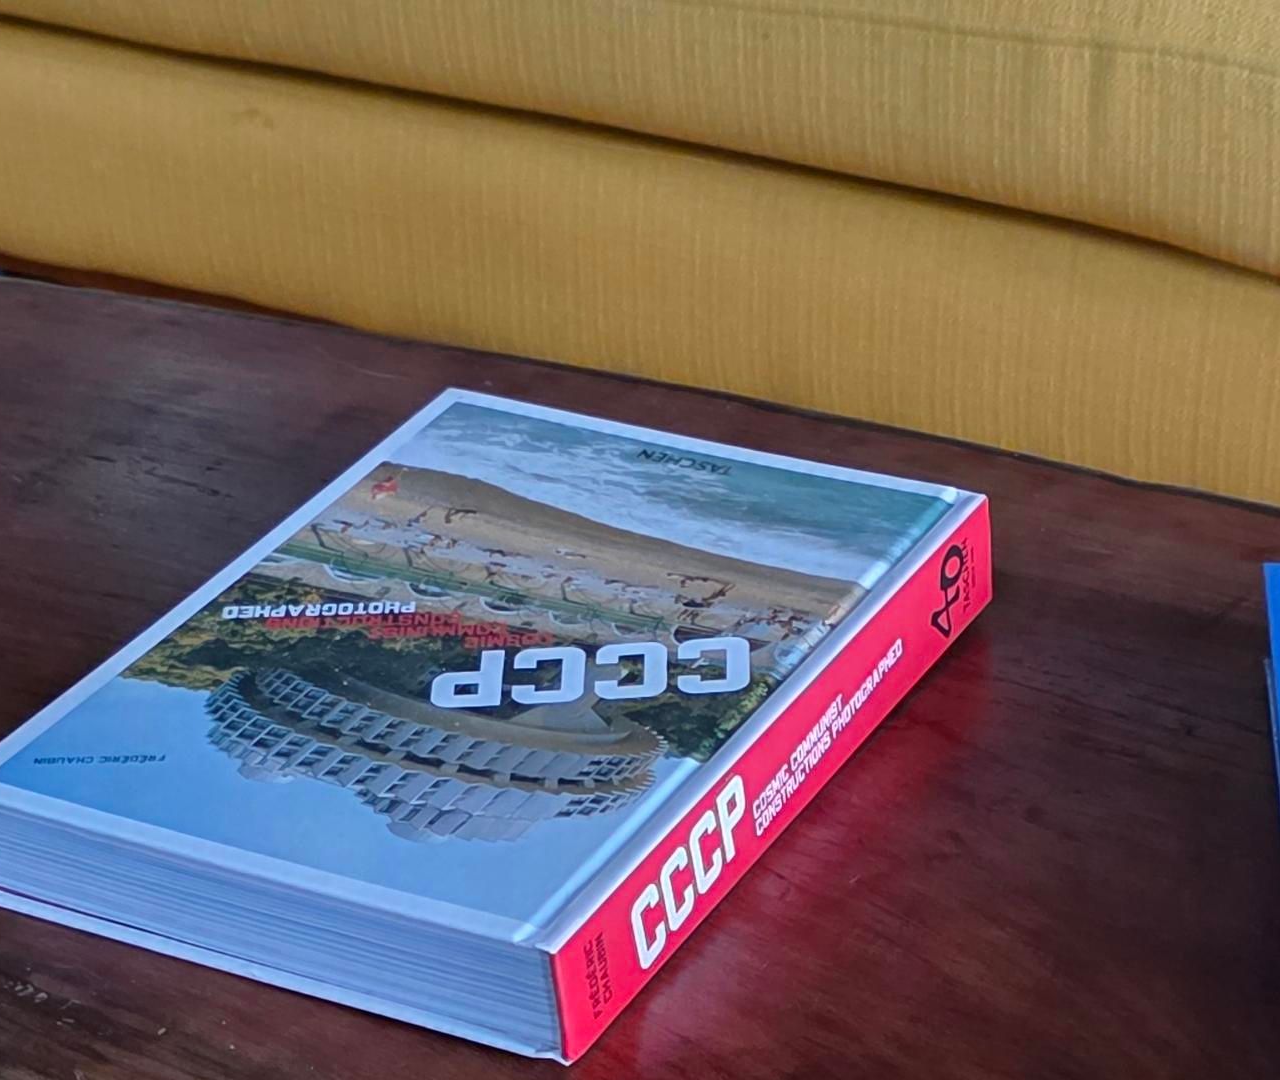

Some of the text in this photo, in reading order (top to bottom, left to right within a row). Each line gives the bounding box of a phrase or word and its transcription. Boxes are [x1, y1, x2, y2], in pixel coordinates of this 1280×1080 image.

[636, 449, 733, 476] TASCHEN
[222, 600, 416, 619] PHOTOGRAPHED
[265, 612, 463, 630] CONSTRUCTIONS
[463, 632, 555, 649] COSMIC
[430, 636, 750, 708] CCCP
[755, 637, 904, 837] CONSTRUCTIONS PHOTOGRAPHED
[33, 755, 94, 765] CHAUBIN
[752, 693, 843, 819] COSMIC COMMUNIST
[630, 774, 746, 970] CCCP
